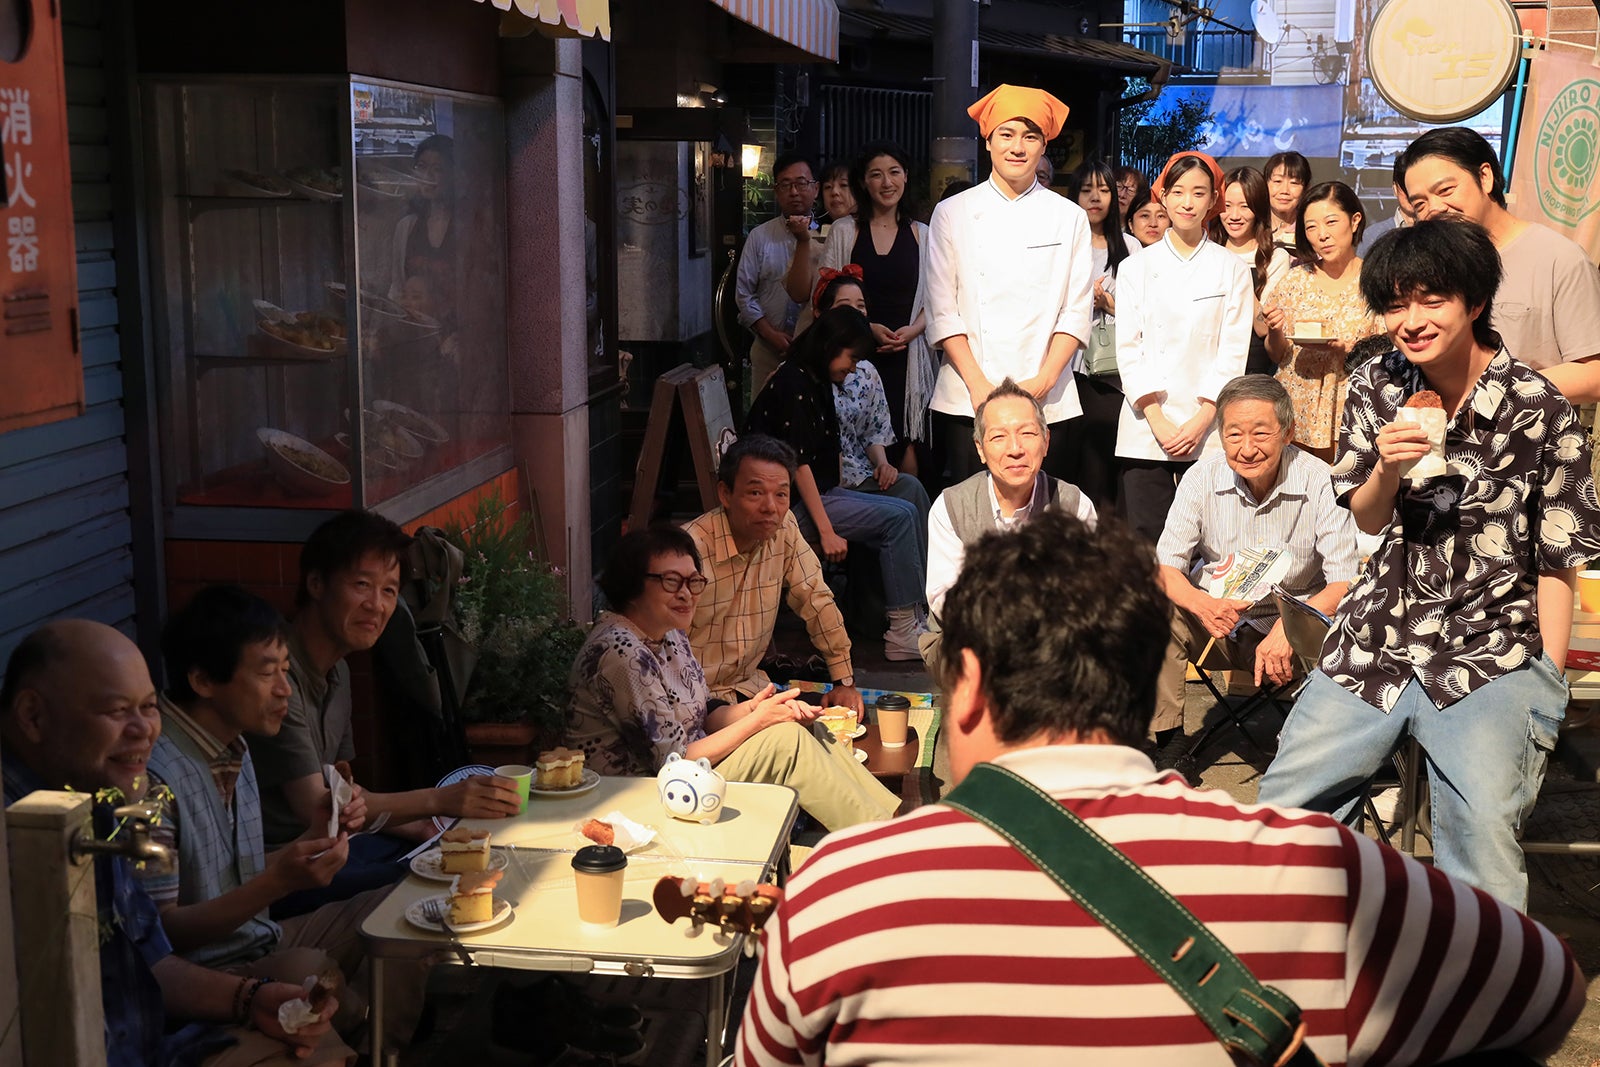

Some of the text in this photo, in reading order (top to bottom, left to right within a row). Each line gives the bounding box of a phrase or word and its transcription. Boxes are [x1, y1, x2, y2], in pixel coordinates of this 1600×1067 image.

[1541, 85, 1591, 148] NIJIIRO
[0, 87, 39, 273] 消火器
